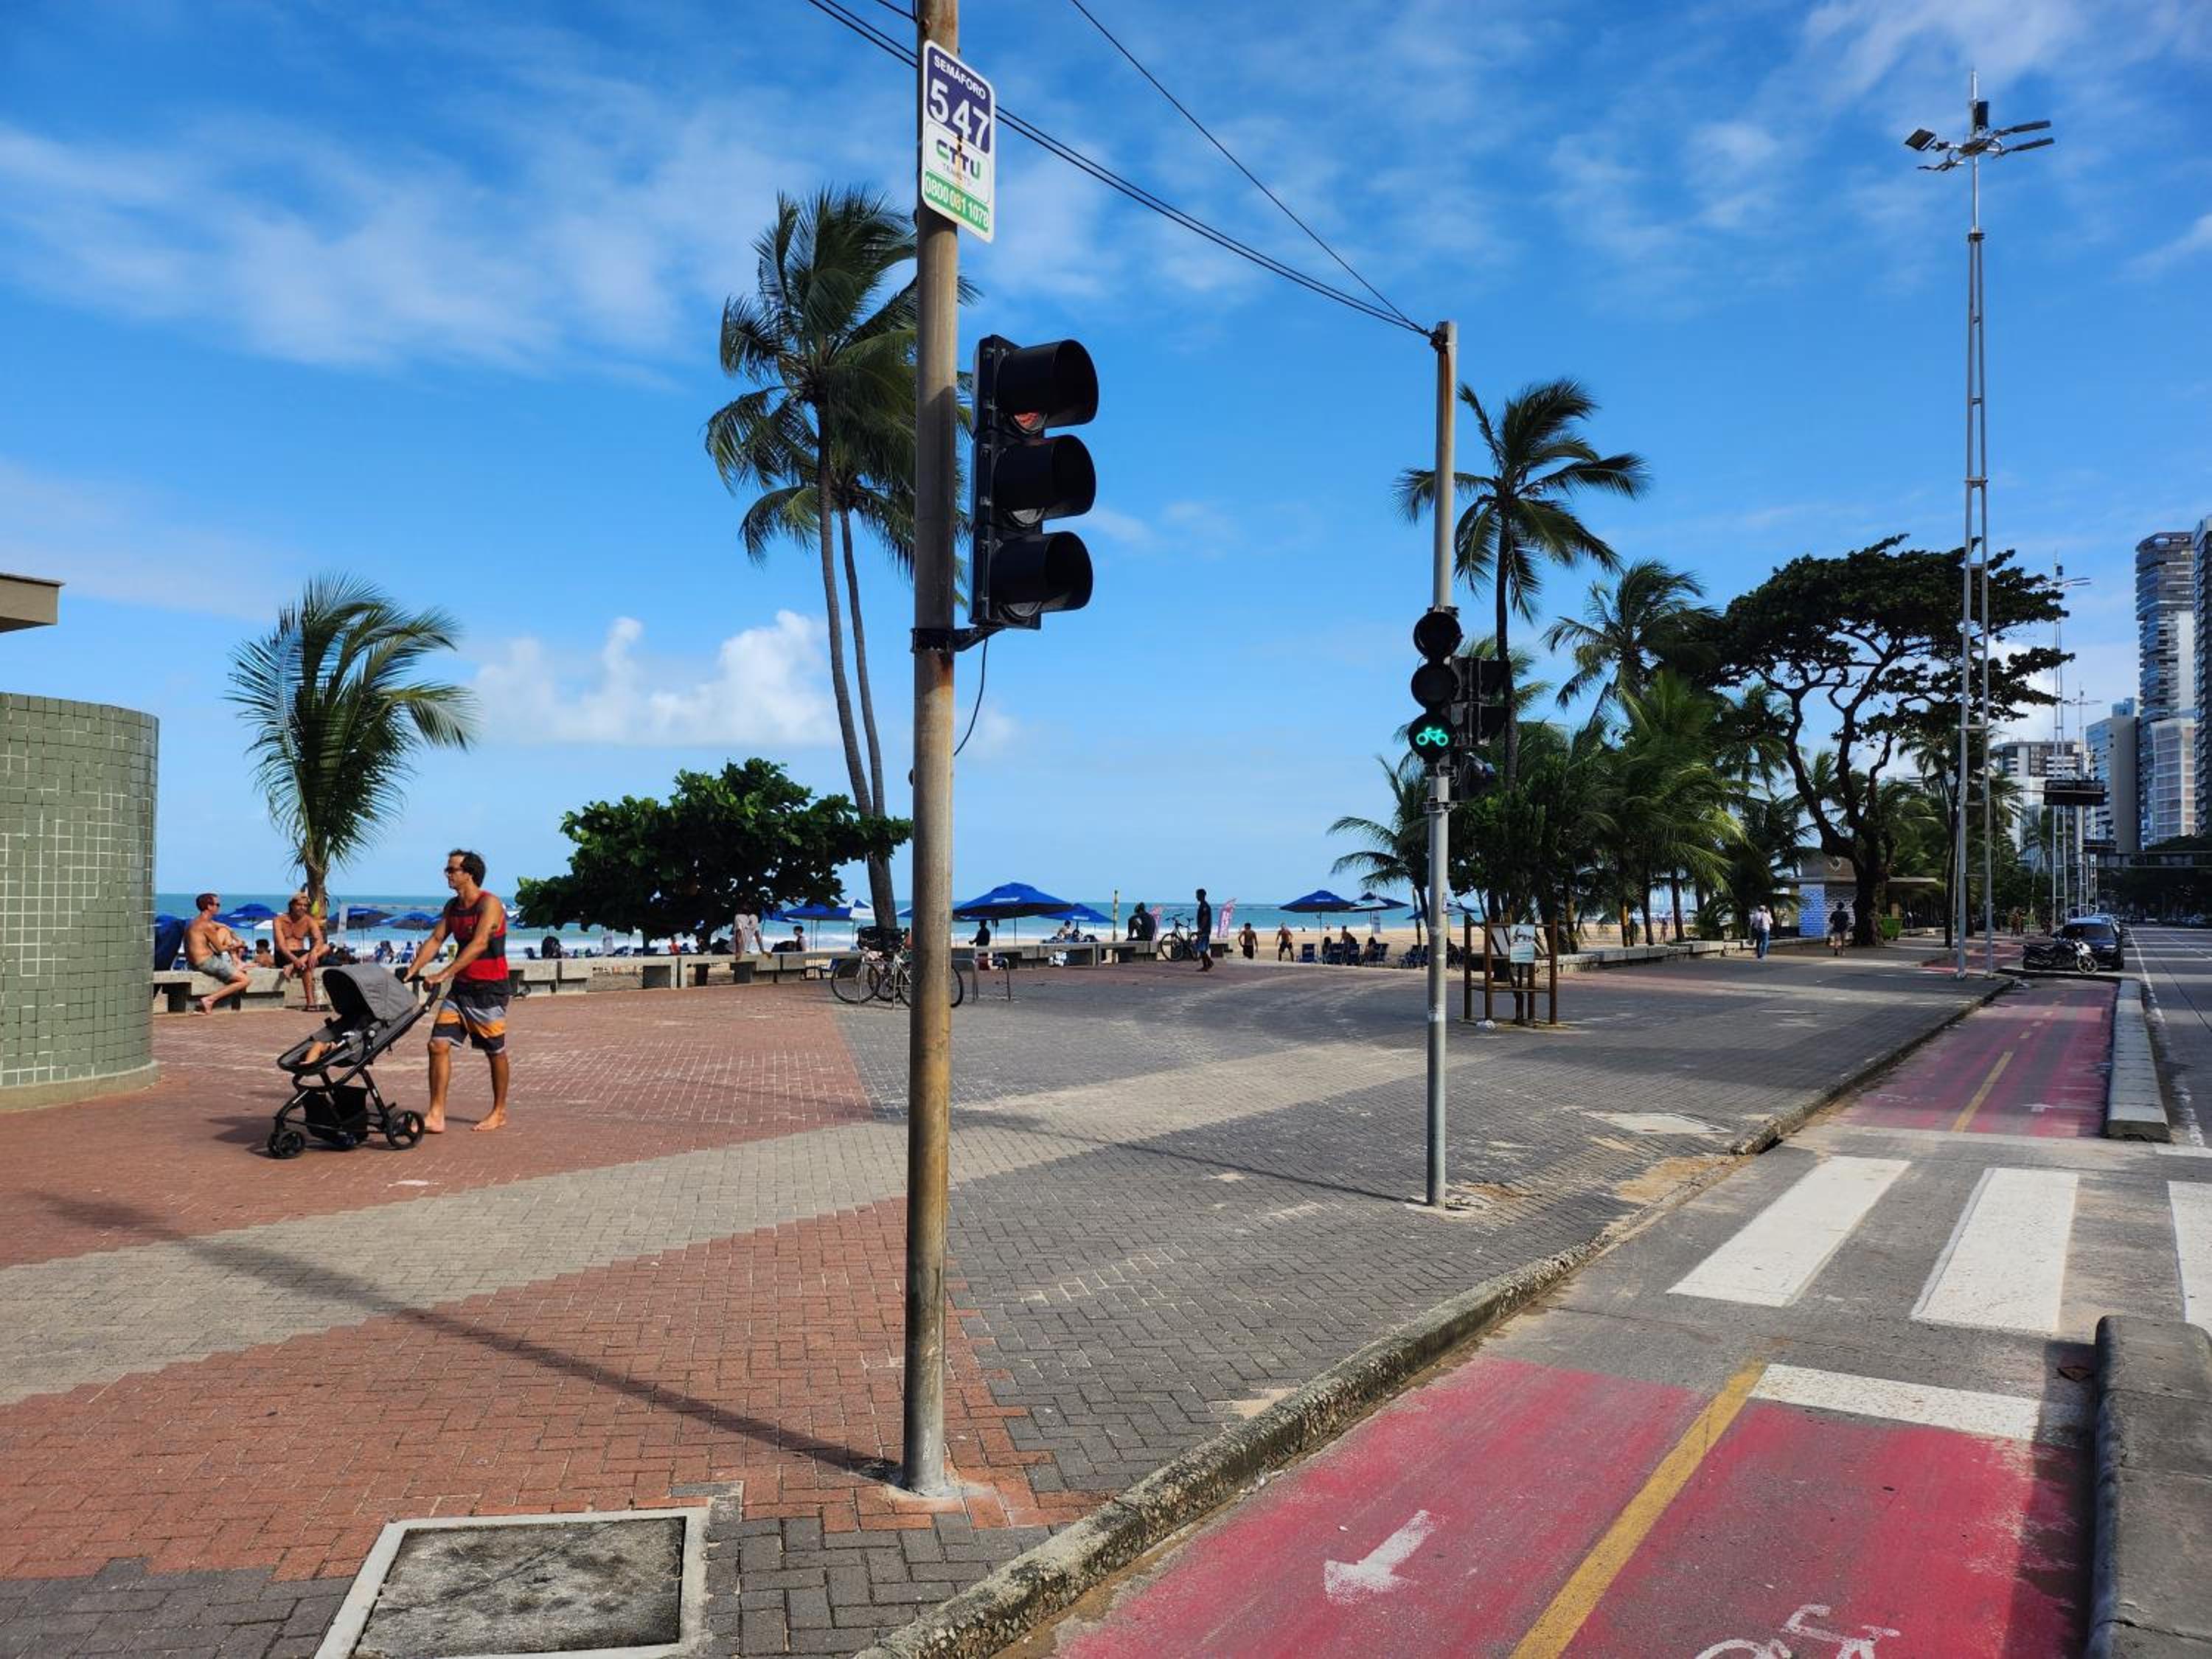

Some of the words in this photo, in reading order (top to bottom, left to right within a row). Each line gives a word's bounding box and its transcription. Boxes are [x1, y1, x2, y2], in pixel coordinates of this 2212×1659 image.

[931, 78, 990, 147] 547
[936, 139, 981, 180] CTTU
[925, 176, 949, 204] 0800
[950, 189, 967, 214] 081
[968, 201, 989, 228] 1078
